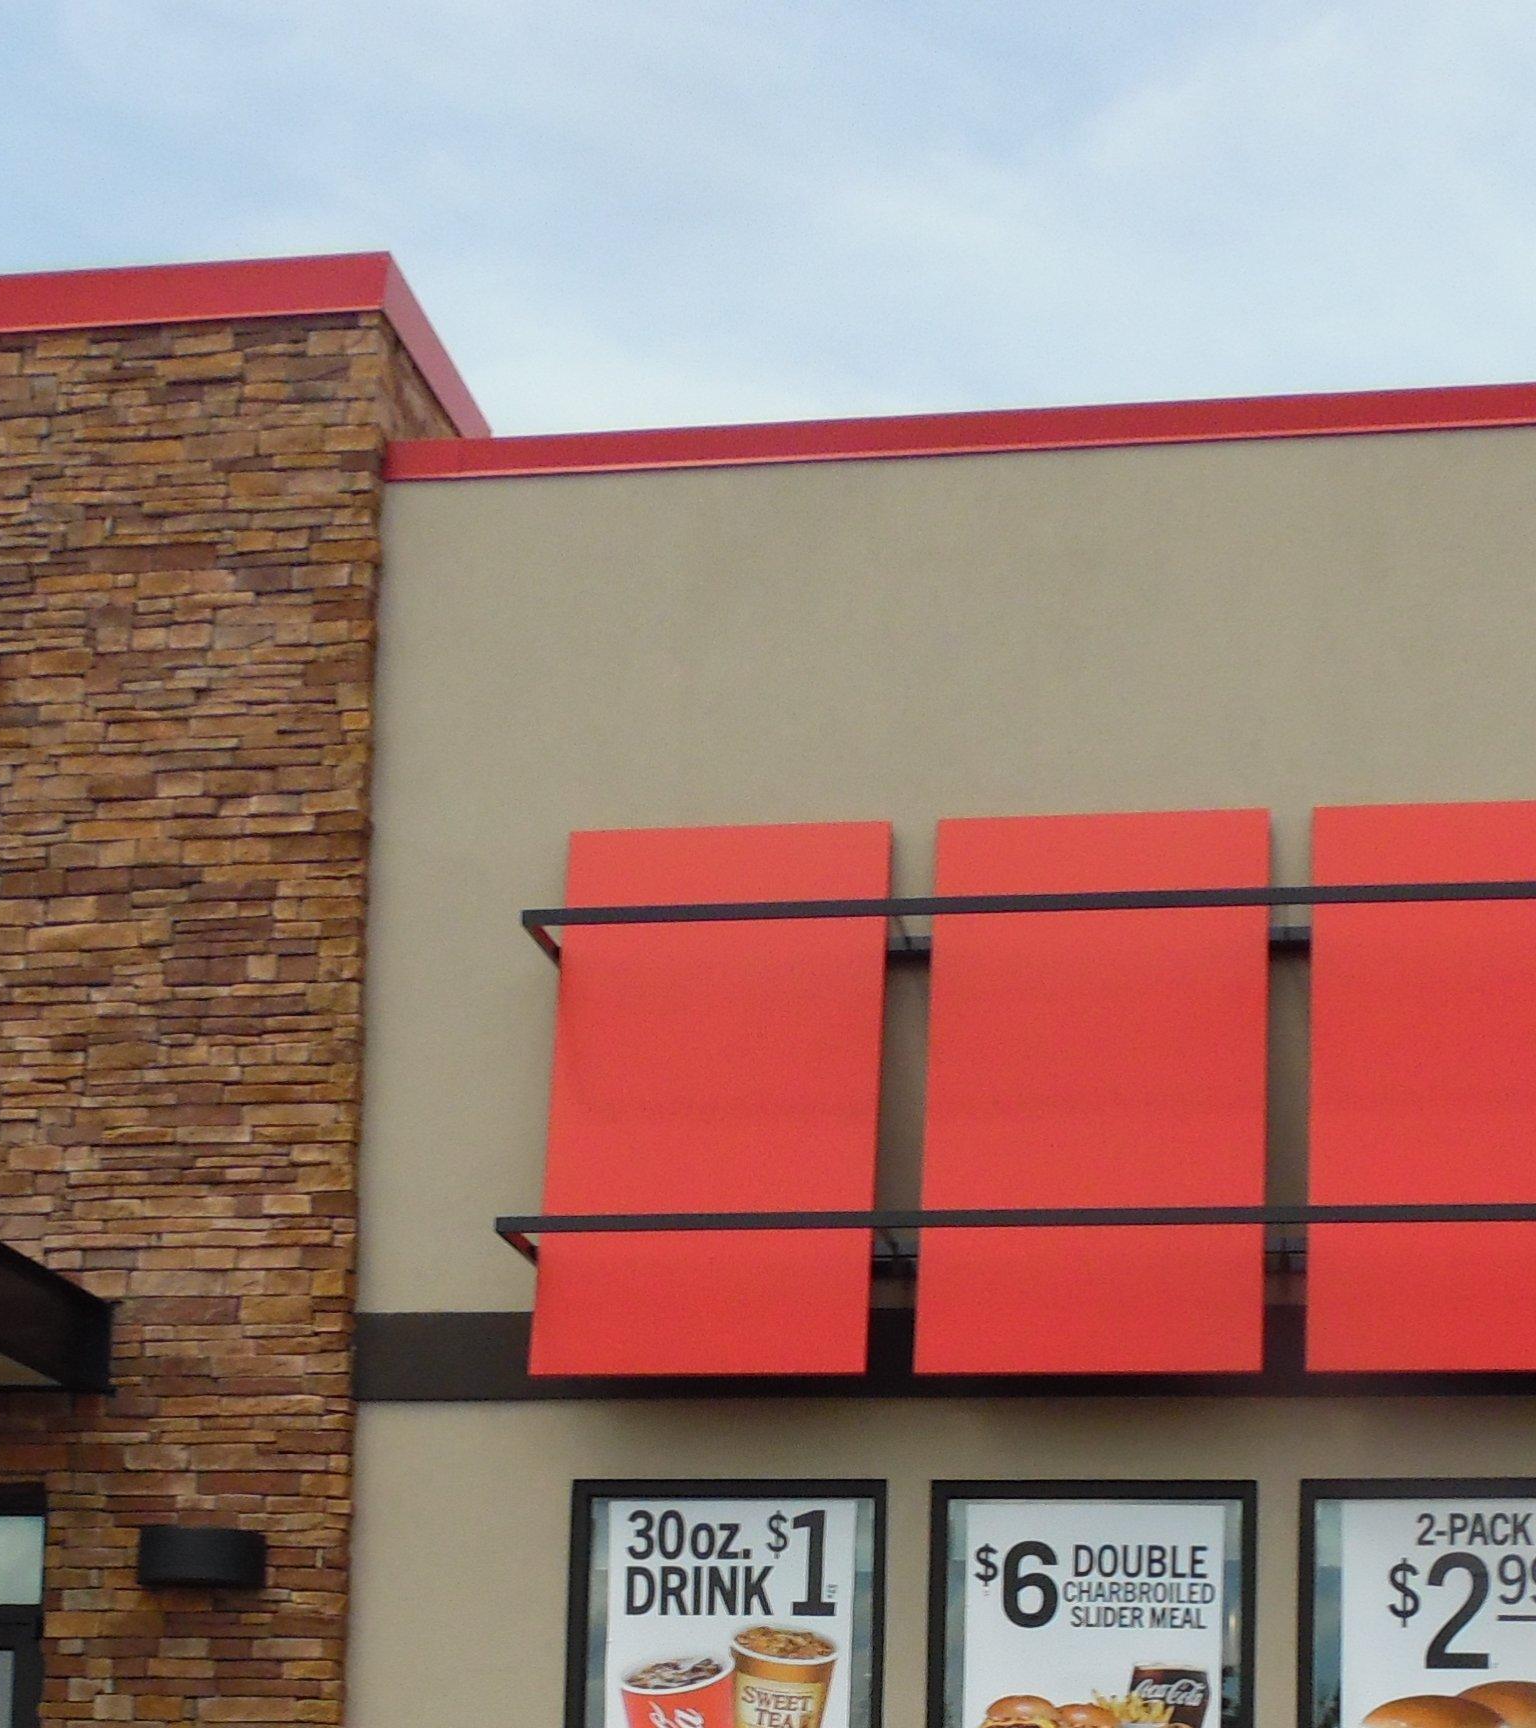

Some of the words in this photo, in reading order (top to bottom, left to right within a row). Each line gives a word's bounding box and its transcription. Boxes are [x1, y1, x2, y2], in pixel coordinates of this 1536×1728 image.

[1417, 1512, 1534, 1546] 2-PACK
[626, 1565, 774, 1616] DRINK
[975, 1540, 1059, 1629] $6
[1073, 1543, 1209, 1579] DOUBLE
[1064, 1580, 1216, 1605] CHARBROILED
[1070, 1606, 1144, 1629] SLIDER
[1149, 1606, 1207, 1630] MEAL
[741, 1685, 813, 1712] SWEET
[755, 1708, 794, 1728] TEA
